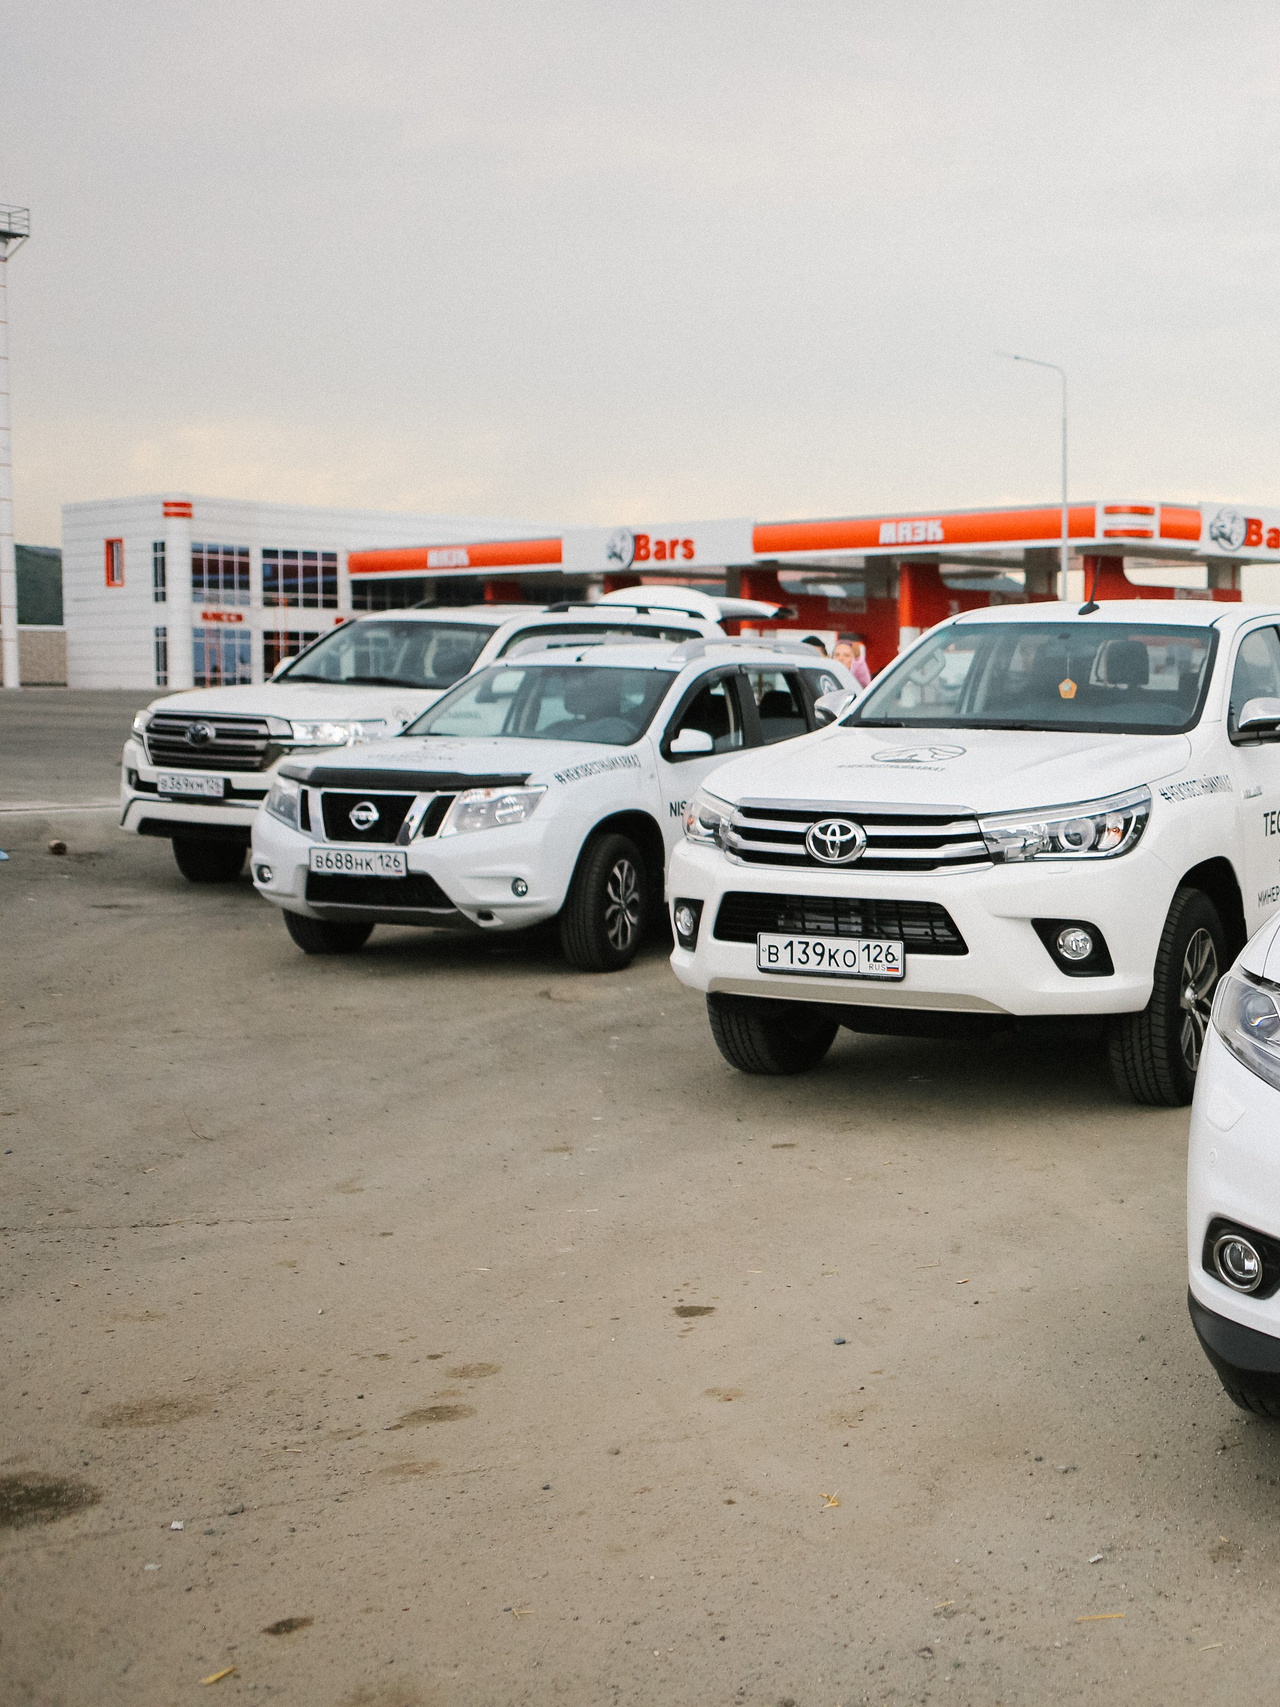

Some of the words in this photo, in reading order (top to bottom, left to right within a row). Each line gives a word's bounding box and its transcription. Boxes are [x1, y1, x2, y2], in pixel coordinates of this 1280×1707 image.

[634, 534, 695, 561] Bars
[315, 852, 373, 871] В688НК
[378, 854, 400, 872] 126
[768, 940, 857, 968] В139КО
[861, 943, 896, 964] 126
[868, 963, 886, 972] RUS
